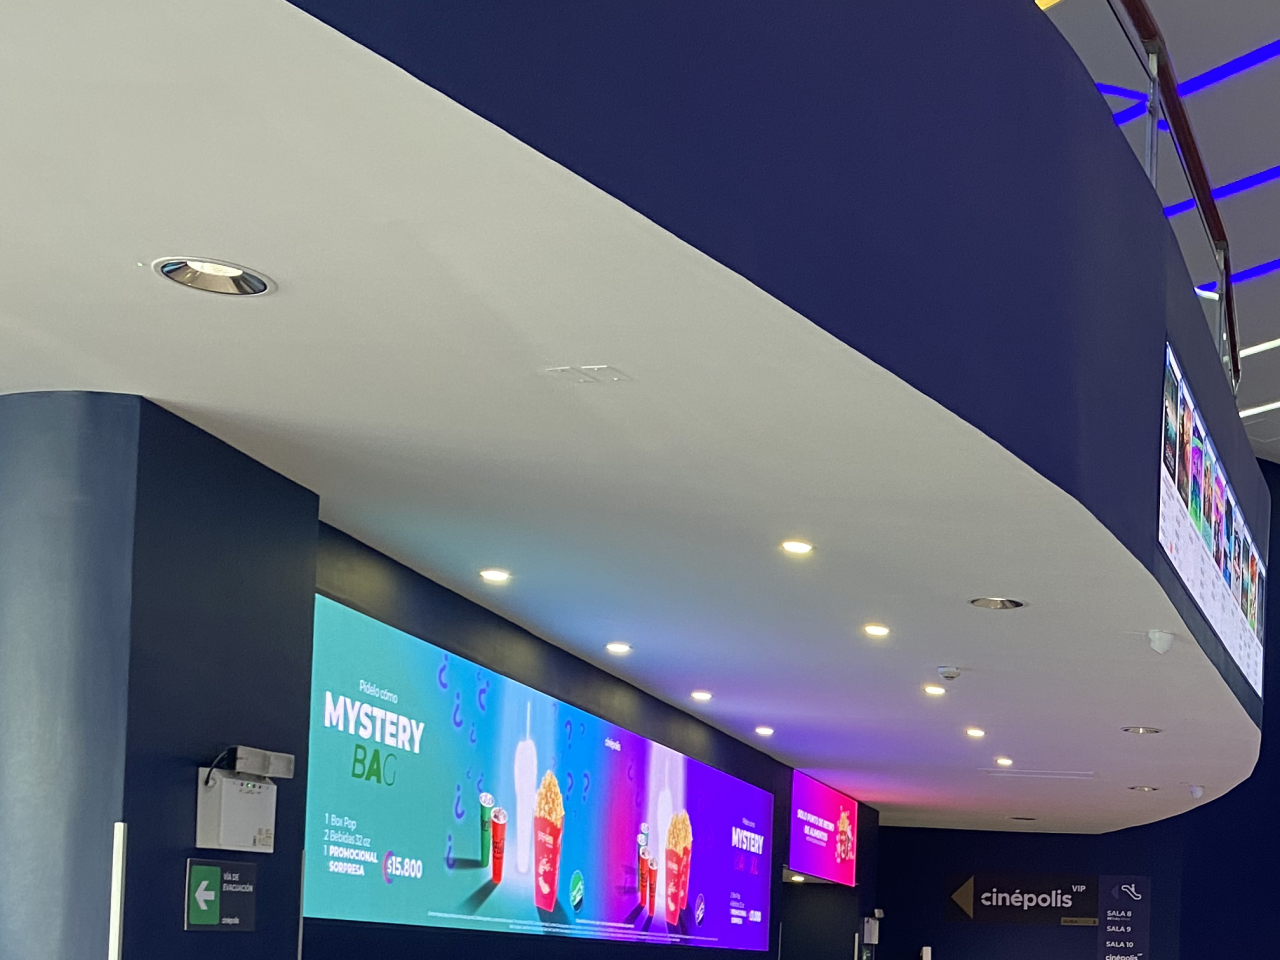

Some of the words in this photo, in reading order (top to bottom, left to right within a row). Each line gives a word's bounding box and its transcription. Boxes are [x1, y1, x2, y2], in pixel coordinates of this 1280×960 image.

[324, 690, 425, 754] MYSTERY
[351, 743, 398, 786] BAG
[330, 813, 343, 828] Box
[343, 816, 357, 831] Pop
[731, 826, 764, 855] MYSTERY
[329, 845, 378, 864] PROMOCIONAL
[386, 855, 423, 879] $15.800
[329, 860, 365, 876] SORPRESA
[980, 887, 1073, 910] cinépolis
[1071, 884, 1087, 893] VIP
